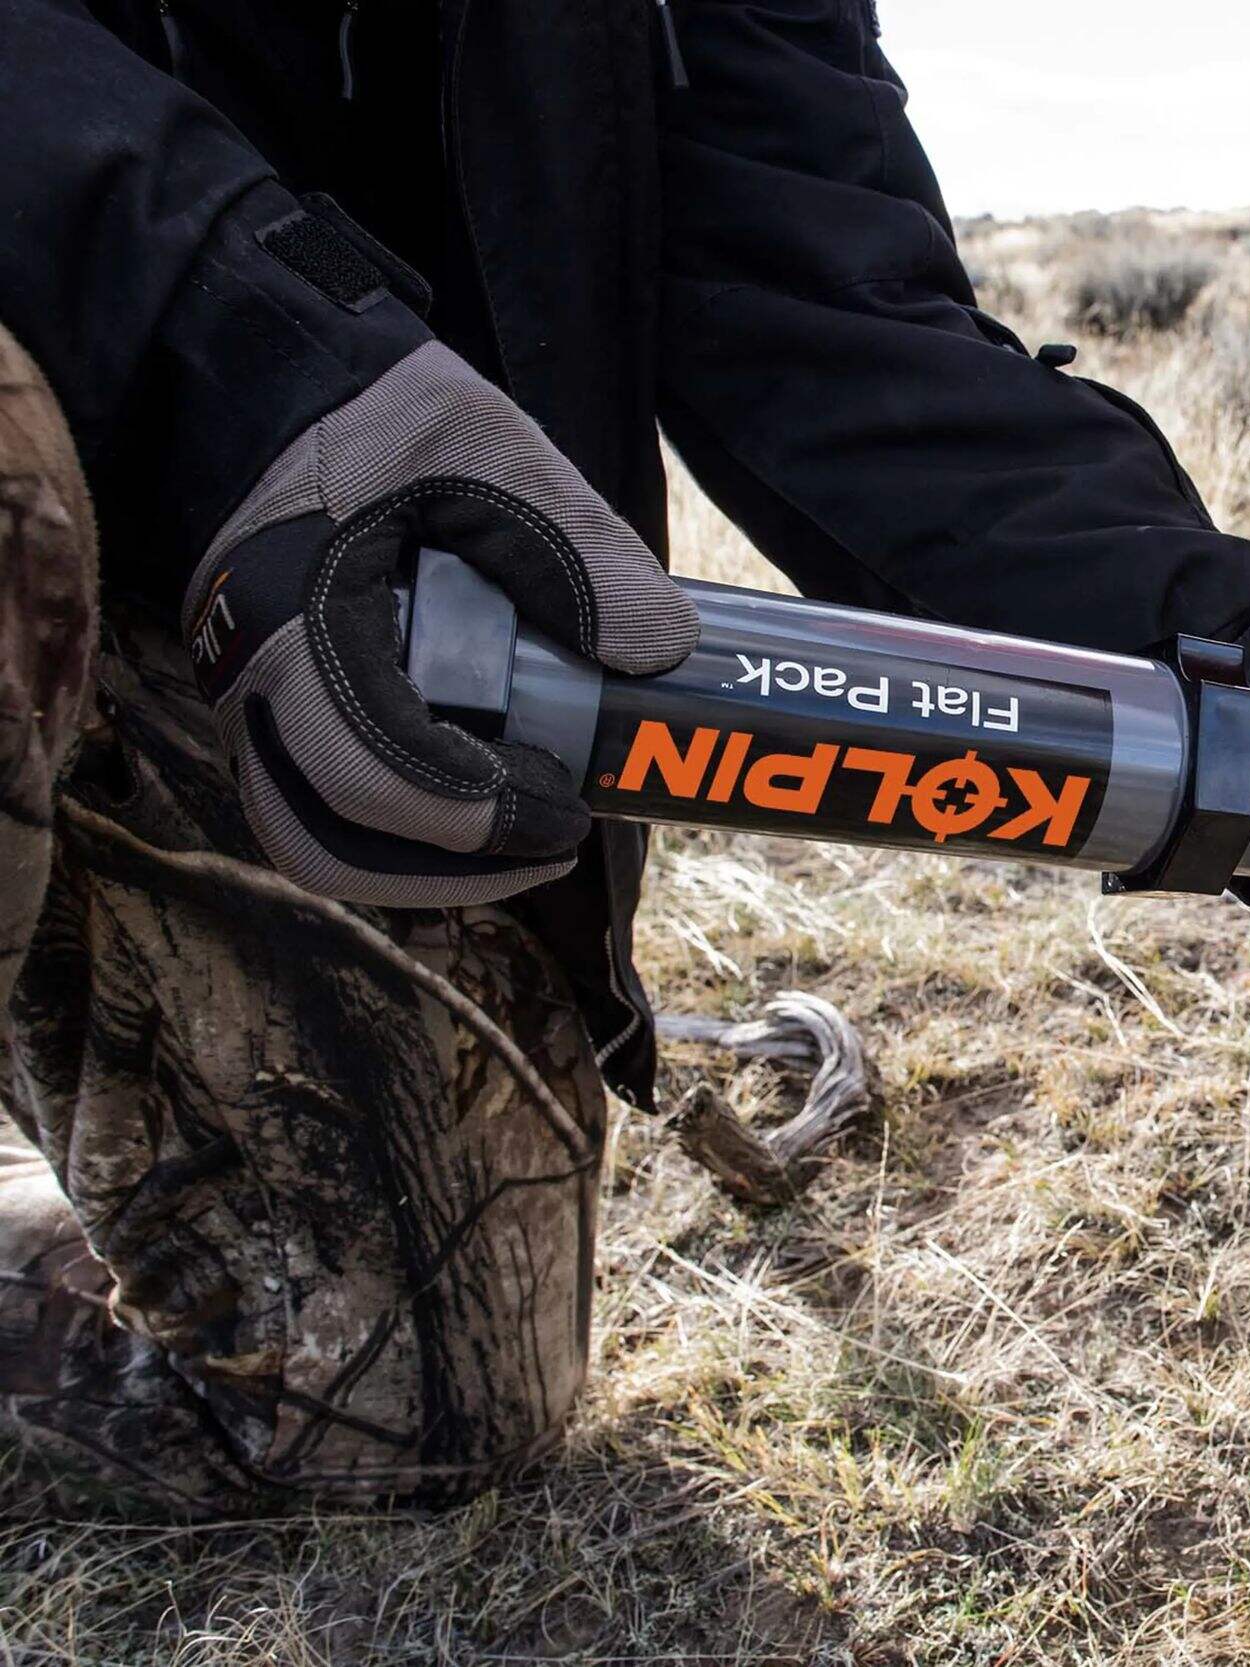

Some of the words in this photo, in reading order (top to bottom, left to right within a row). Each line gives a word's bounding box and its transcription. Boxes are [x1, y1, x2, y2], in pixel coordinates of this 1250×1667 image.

[736, 654, 889, 713] Pack
[911, 681, 1019, 732] Flat
[617, 721, 1091, 846] KOLPIN
